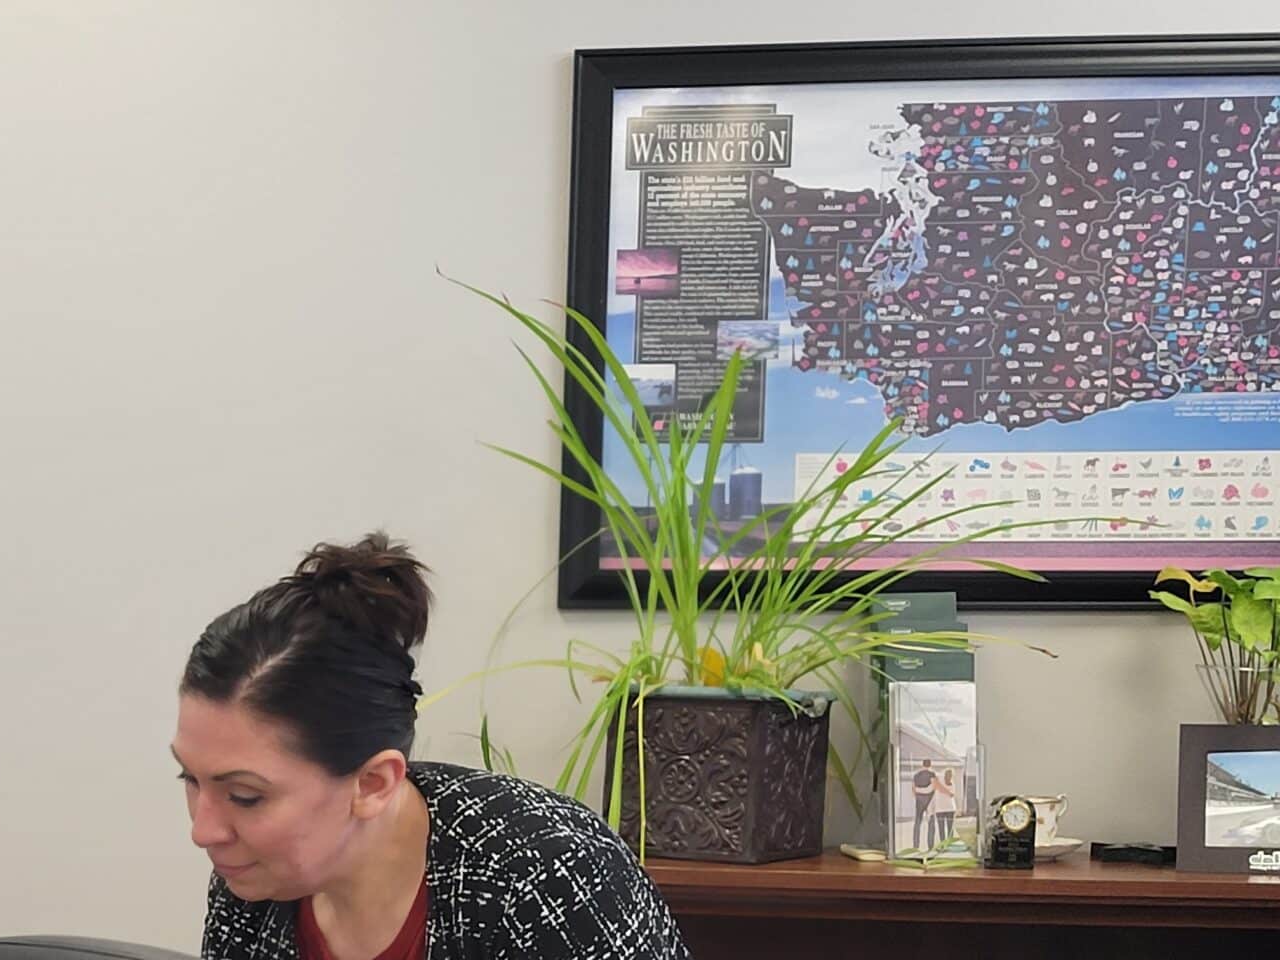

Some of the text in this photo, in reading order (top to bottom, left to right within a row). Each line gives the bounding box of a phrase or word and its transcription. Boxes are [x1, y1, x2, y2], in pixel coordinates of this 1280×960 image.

[657, 122, 766, 139] THE FRESH TASTE OF
[632, 131, 786, 164] WASHINGTON
